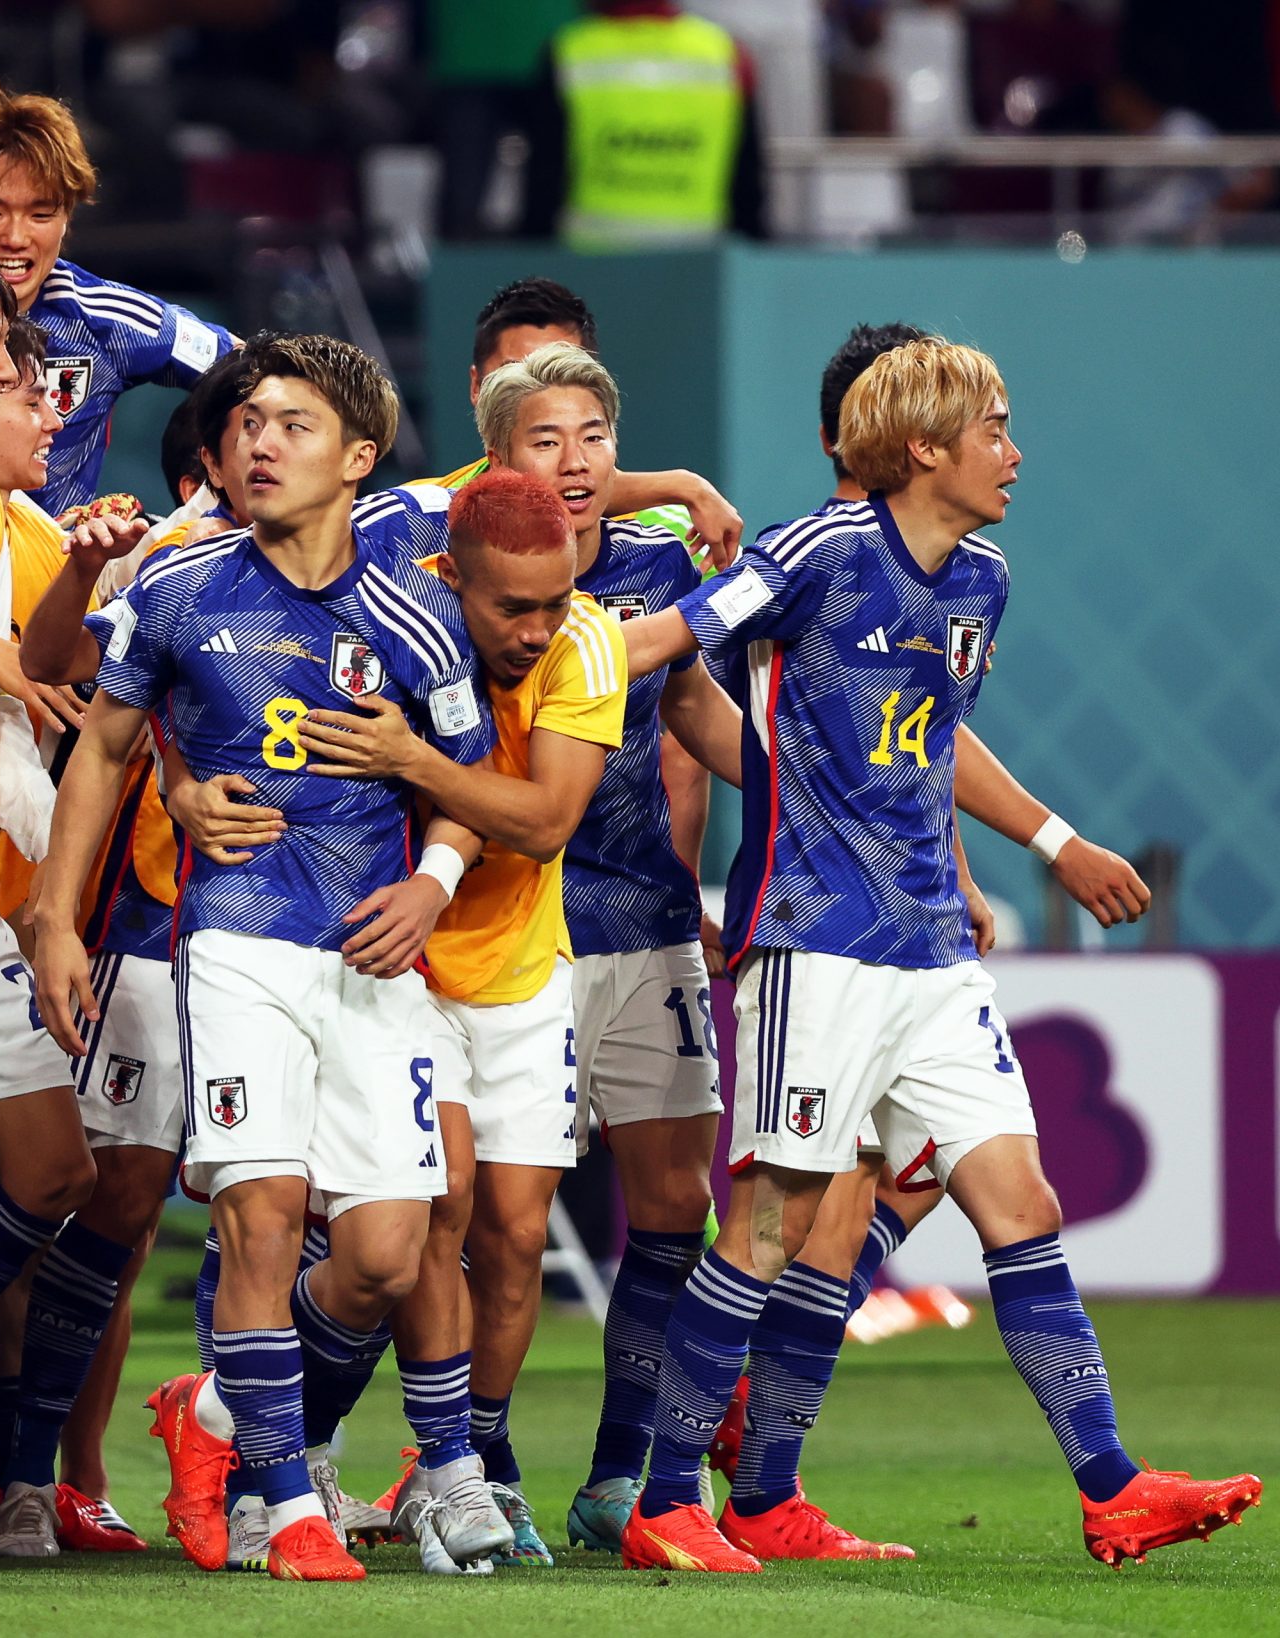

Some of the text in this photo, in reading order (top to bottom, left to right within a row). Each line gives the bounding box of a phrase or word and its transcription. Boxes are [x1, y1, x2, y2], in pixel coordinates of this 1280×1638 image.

[262, 697, 309, 770] 8
[869, 691, 935, 768] 14
[978, 1006, 1016, 1073] 1
[215, 1077, 236, 1085] JAPAN
[410, 1057, 434, 1131] 8
[31, 1308, 103, 1340] JAPAN
[1067, 1365, 1108, 1380] JAP
[1105, 1508, 1150, 1520] ULTRA
